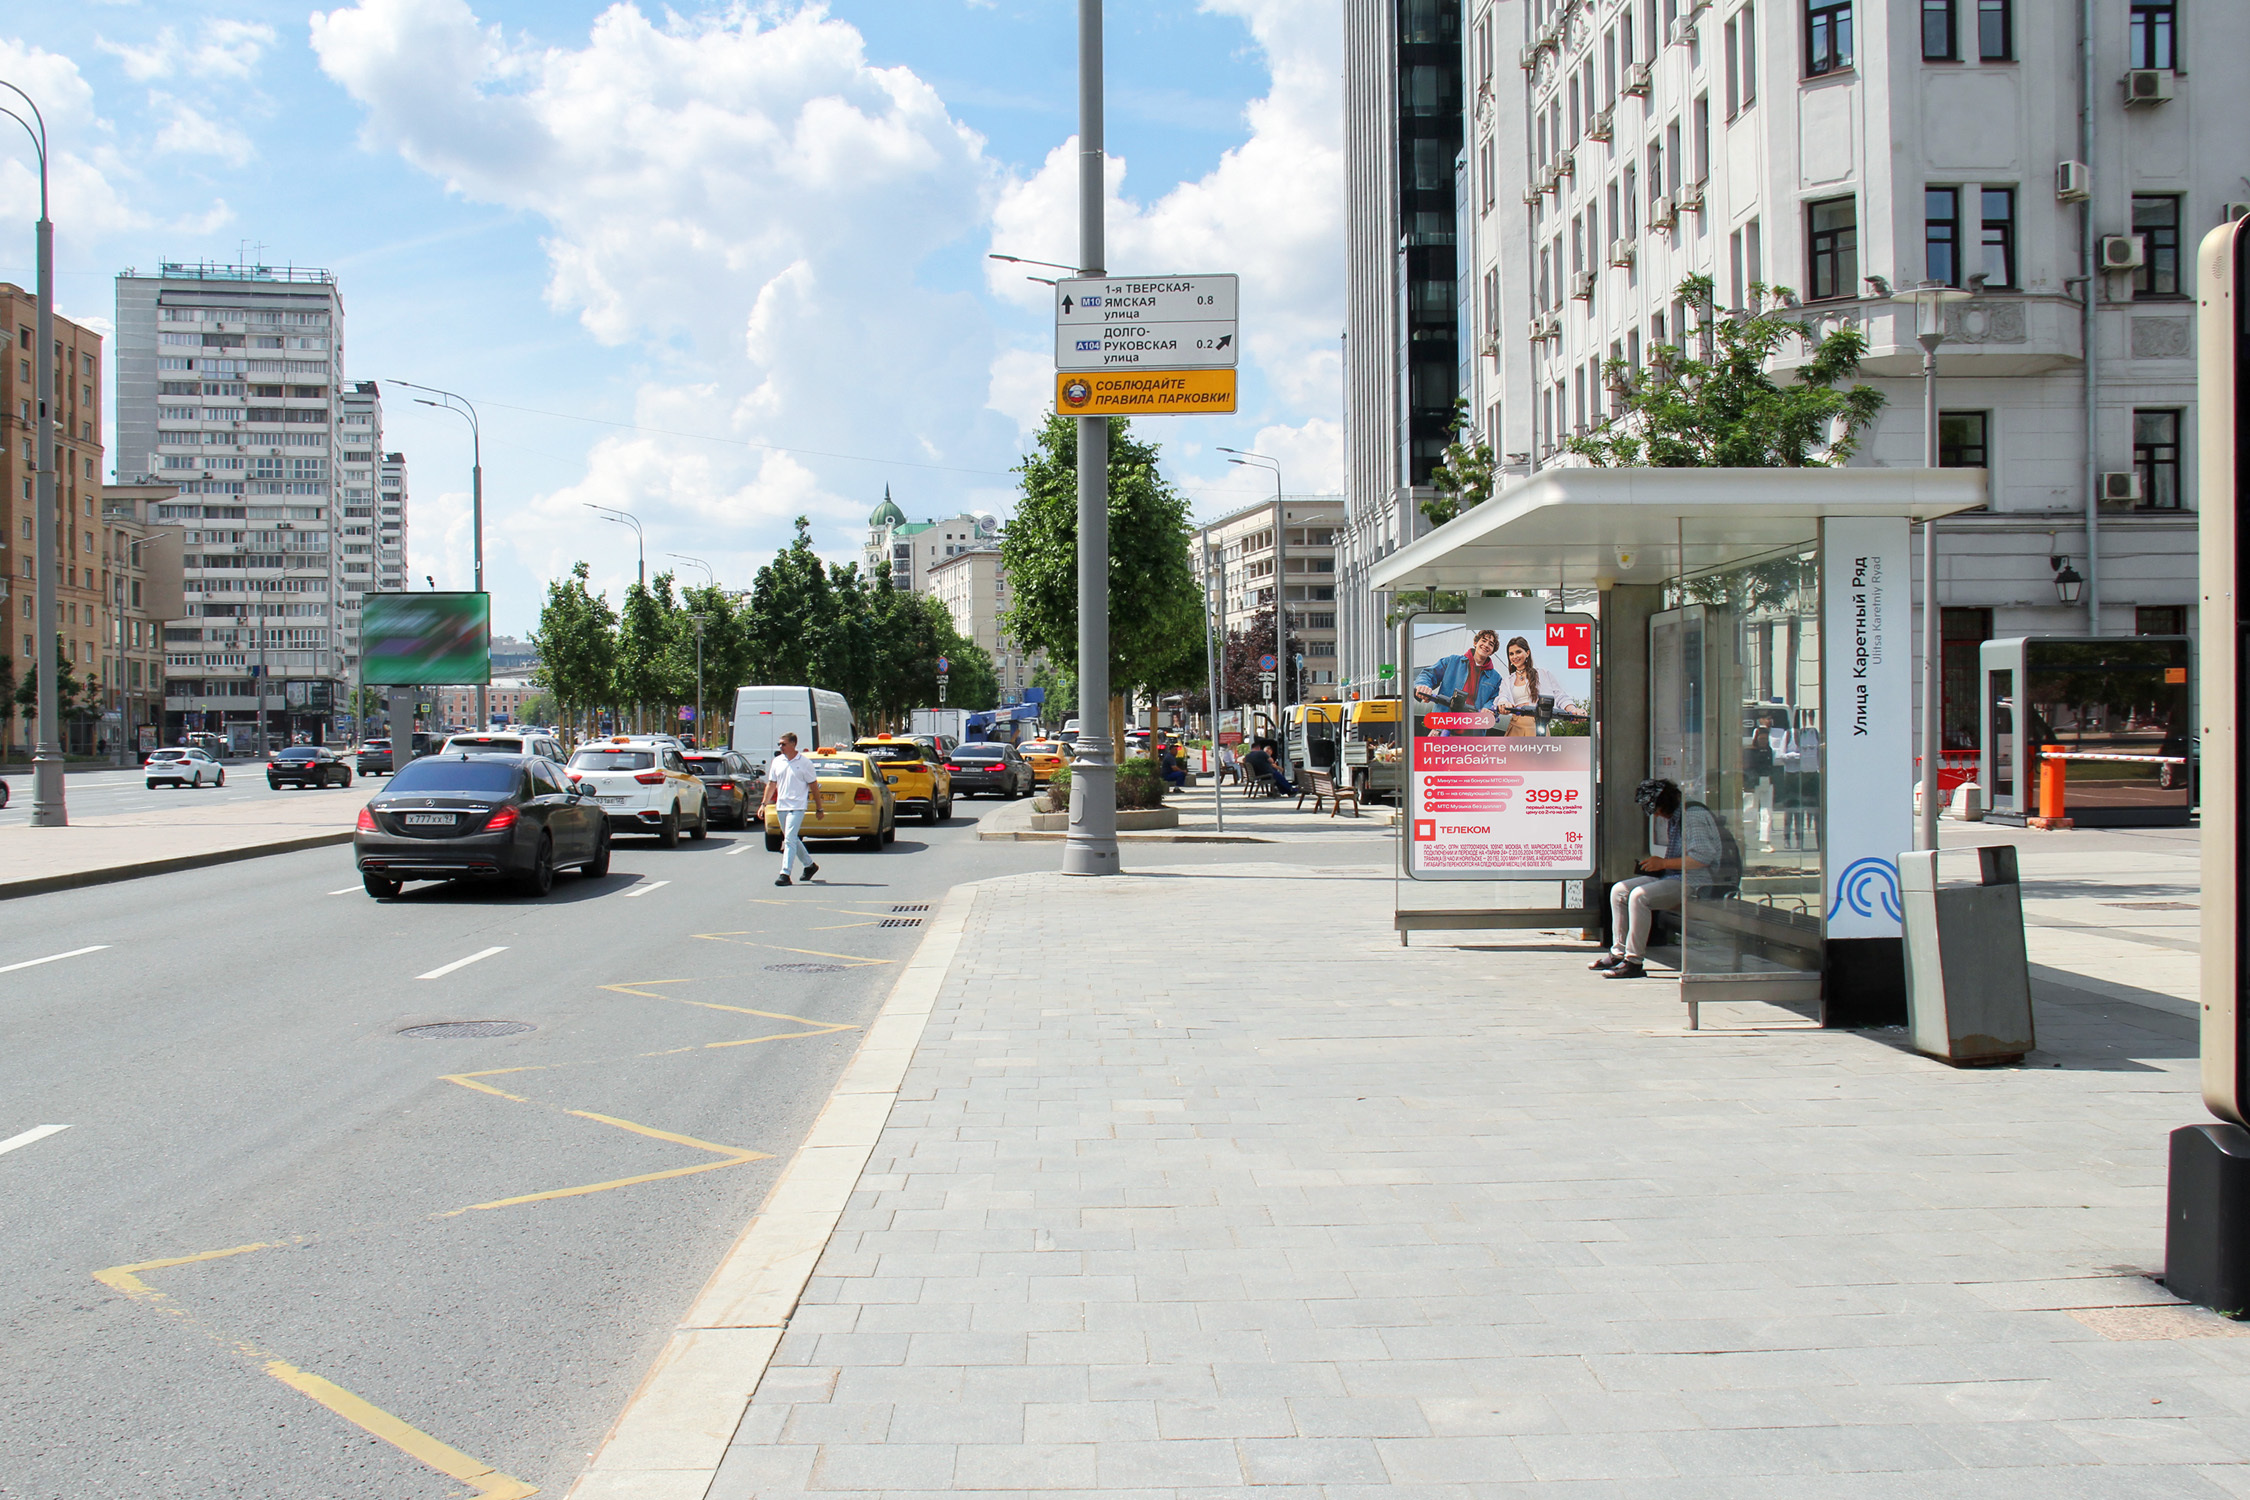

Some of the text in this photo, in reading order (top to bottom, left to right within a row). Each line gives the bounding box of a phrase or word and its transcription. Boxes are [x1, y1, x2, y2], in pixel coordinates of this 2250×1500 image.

[1105, 282, 1195, 294] 1-я ТВЕРСКАЯ-
[1104, 297, 1156, 307] ЯМСКАЯ
[1197, 295, 1214, 305] 0.8
[1104, 310, 1140, 321] улица
[1104, 327, 1150, 339] ДОЛГО-
[1104, 340, 1177, 351] РУКОВСКАЯ
[1196, 339, 1213, 349] 0.2
[1104, 353, 1139, 364] улица
[1096, 378, 1186, 391] СОБЛЮДАЙТЕ
[1095, 393, 1230, 405] ПРАВИЛА ПАРКОВКИ!
[1871, 556, 1883, 665] Ulitsa Karetniy Ryad
[1852, 557, 1869, 736] Улица Каретный Ряд
[1431, 716, 1489, 725] ТАРИФ 24
[1423, 742, 1562, 754] Переносите минуты
[1423, 754, 1507, 765] и гигабайты
[1525, 789, 1562, 802] 399
[1440, 826, 1491, 834] ТЕЛЕКОМ
[1565, 831, 1583, 842] 18+
